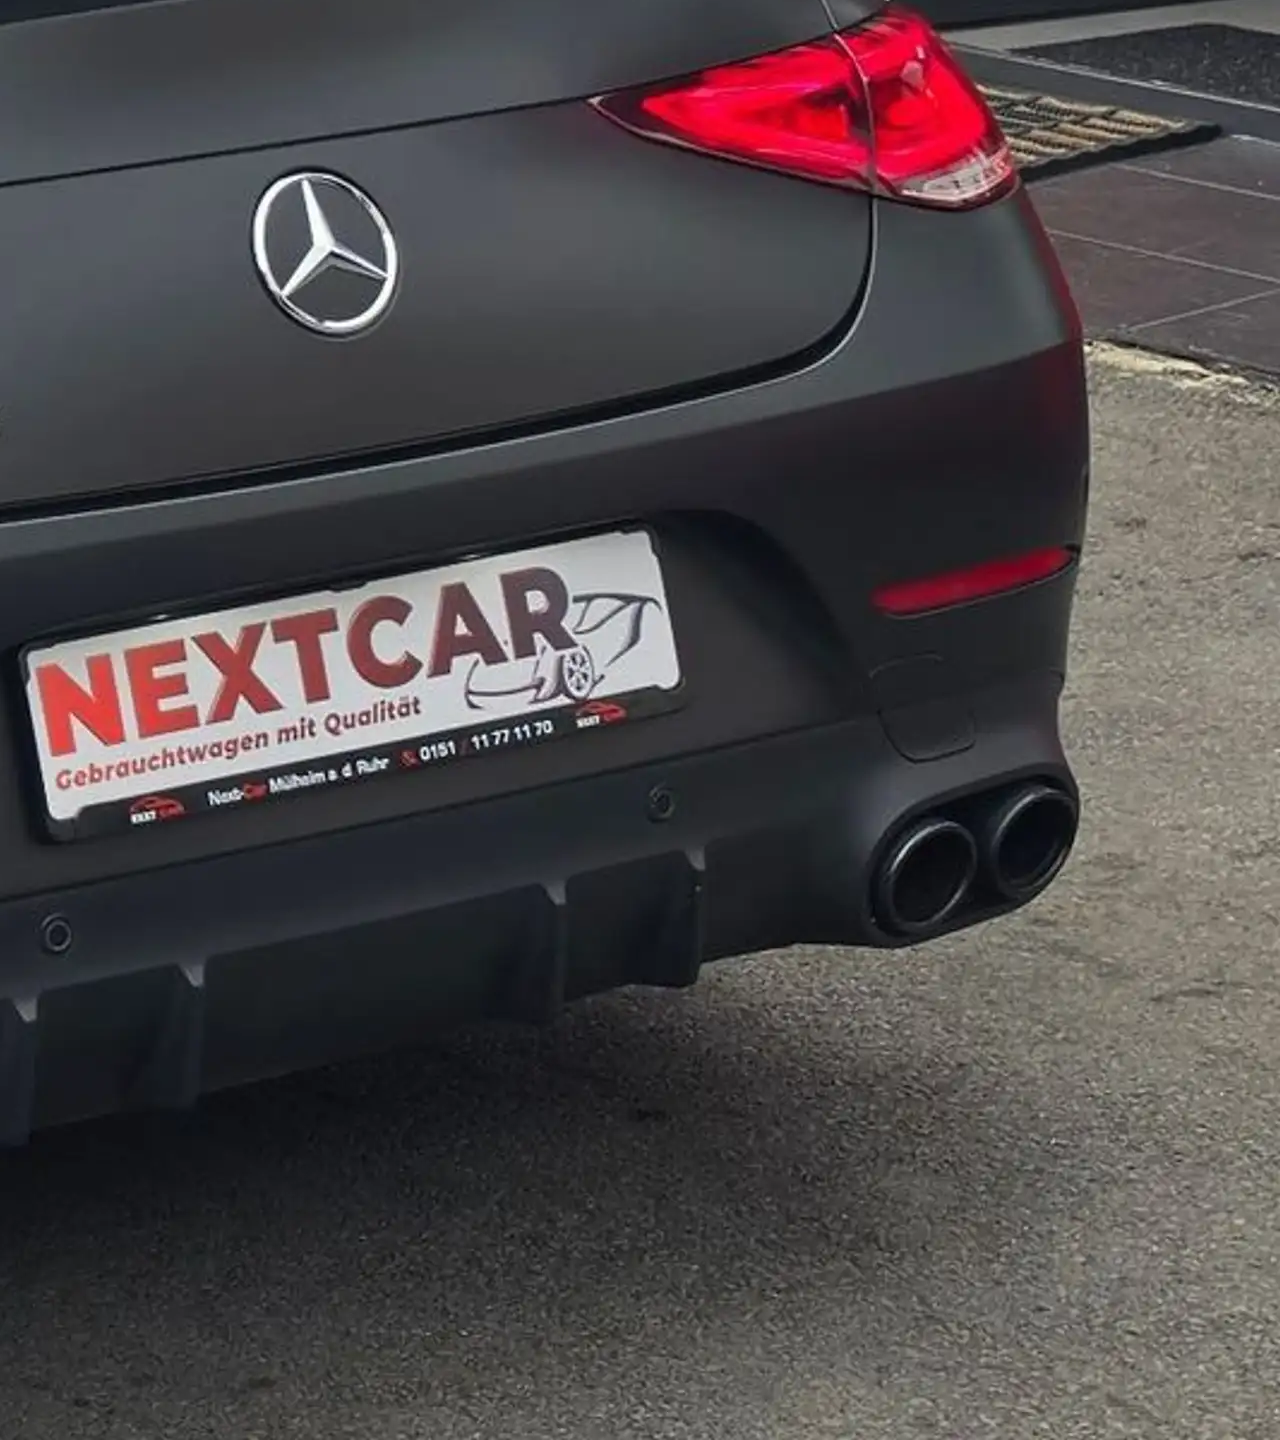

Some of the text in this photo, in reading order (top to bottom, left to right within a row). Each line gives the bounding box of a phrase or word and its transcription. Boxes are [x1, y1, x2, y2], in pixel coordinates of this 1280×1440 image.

[35, 565, 578, 757] NEXTCAR
[54, 695, 423, 791] Gebrauchtwagen mit Qualität
[269, 766, 327, 793] Mülheim
[356, 756, 390, 776] Ruhr
[418, 739, 457, 761] 0151
